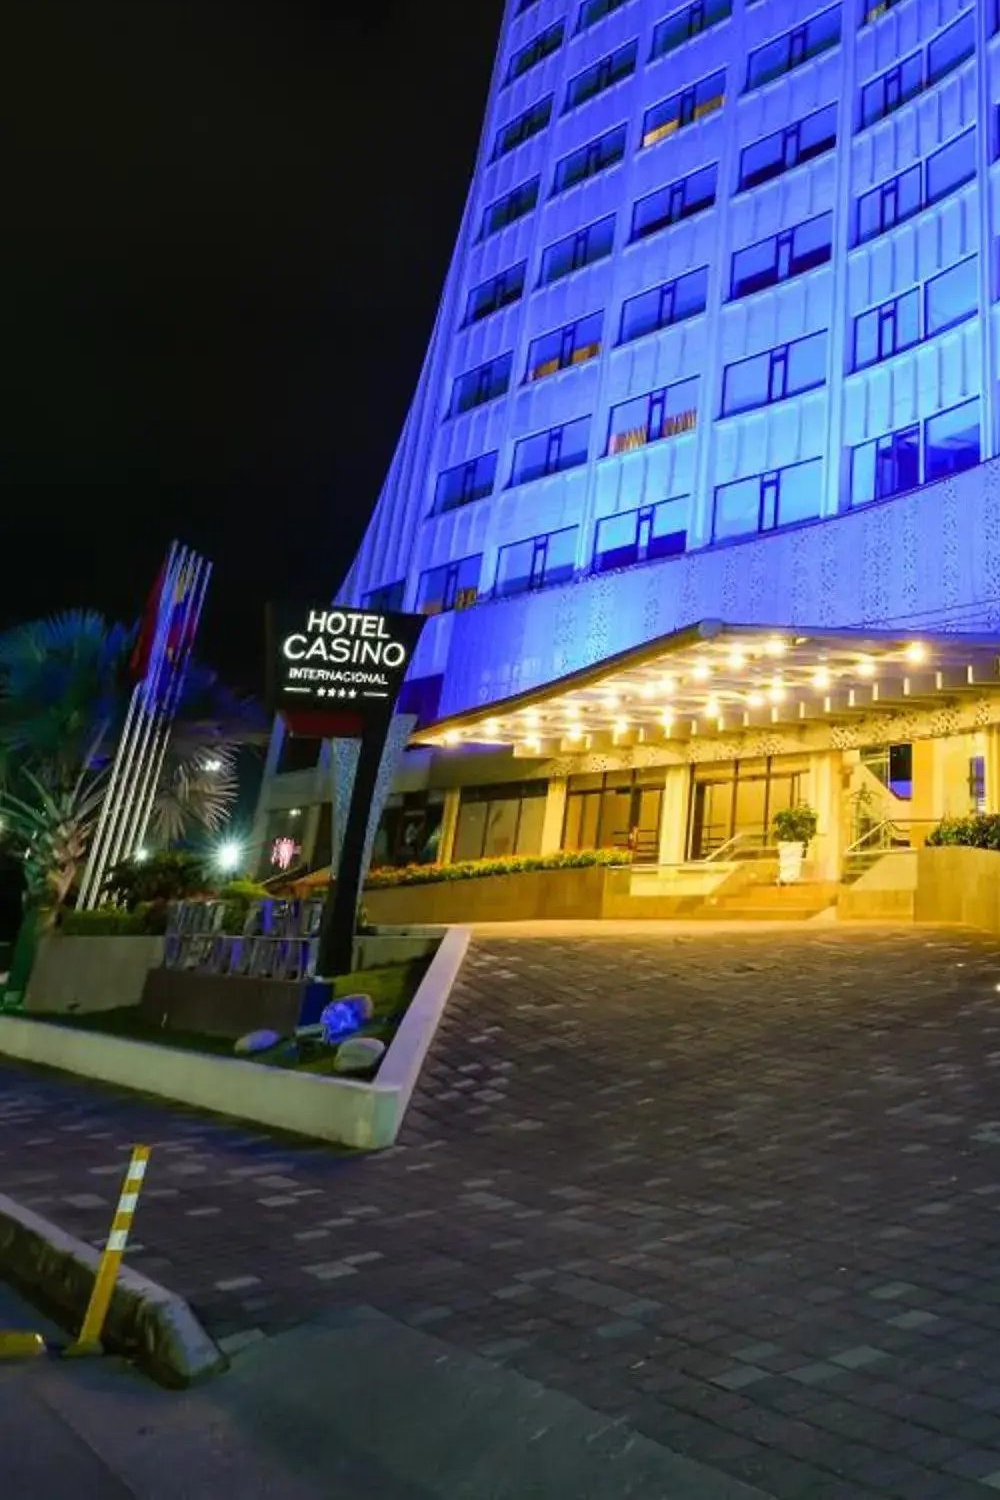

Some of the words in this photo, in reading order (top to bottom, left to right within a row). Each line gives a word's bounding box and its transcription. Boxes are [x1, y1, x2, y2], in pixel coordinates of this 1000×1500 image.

[308, 610, 391, 639] HOTEL
[283, 634, 405, 667] CASINO
[289, 667, 389, 685] INTERNACIONAL
